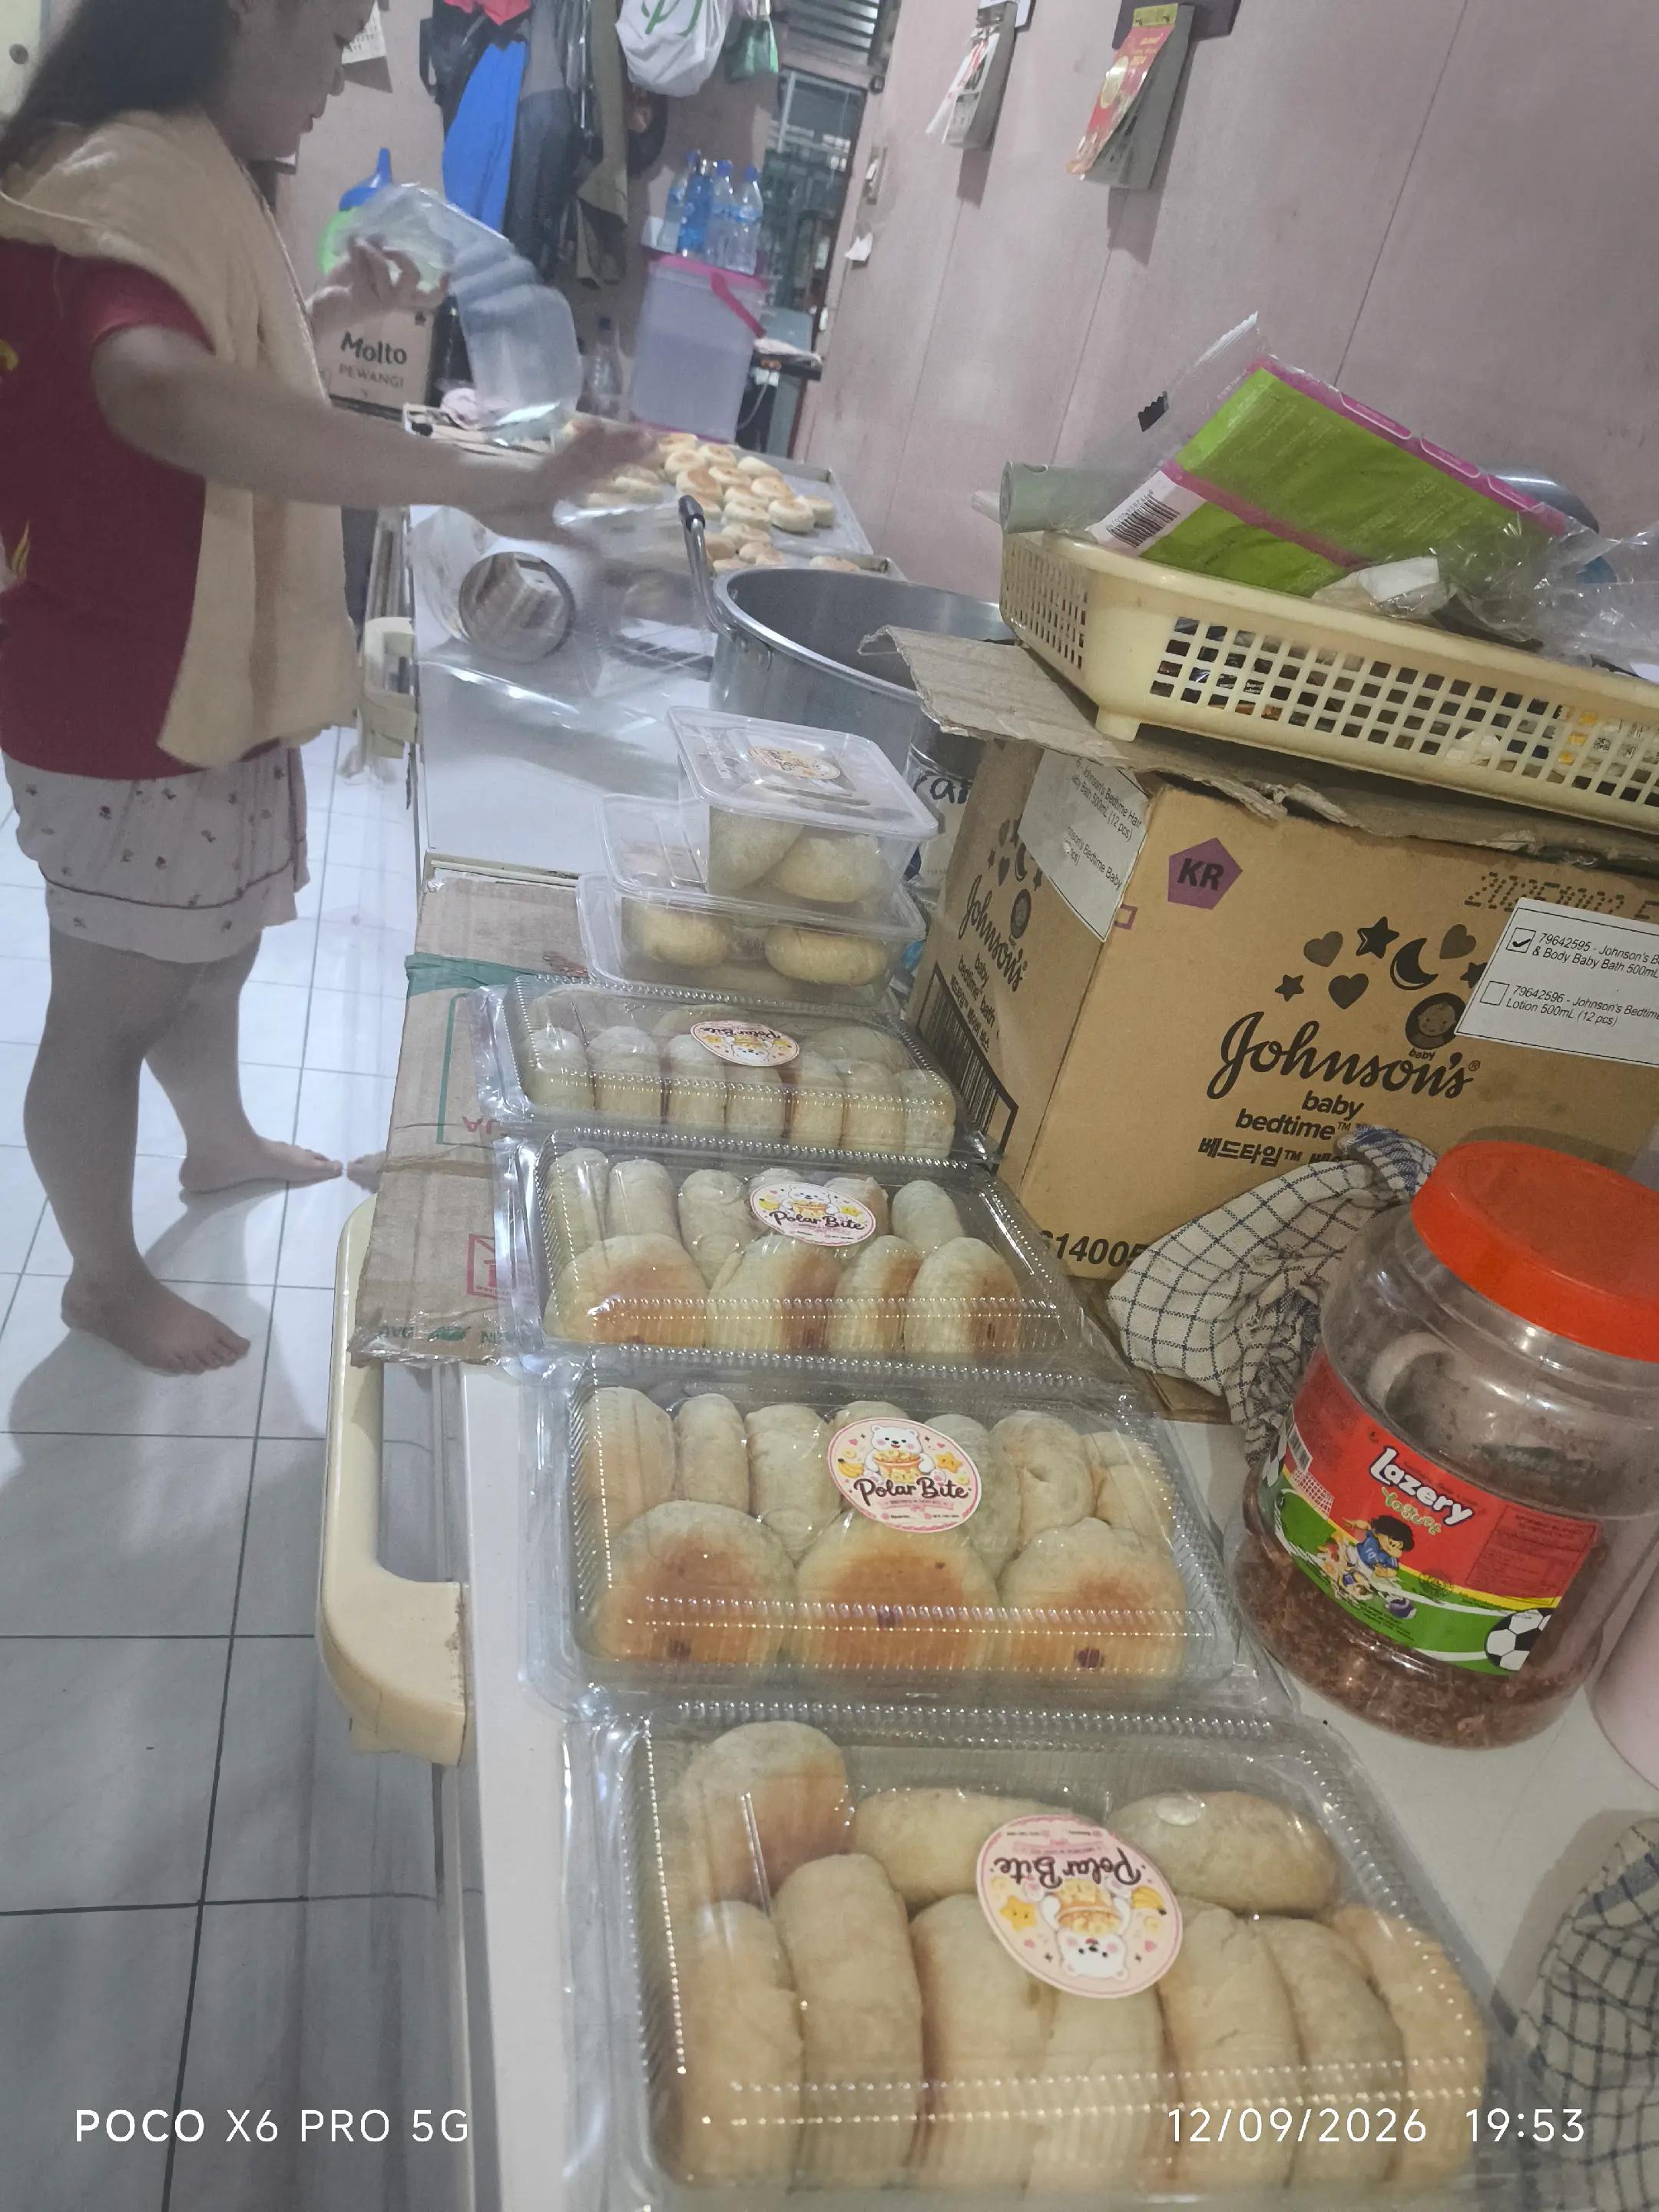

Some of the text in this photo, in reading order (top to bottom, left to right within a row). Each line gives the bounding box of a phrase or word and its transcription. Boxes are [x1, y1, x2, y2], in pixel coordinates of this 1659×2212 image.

[340, 332, 407, 365] Molto
[339, 363, 404, 388] PEWANGI
[1105, 866, 1123, 891] Baby
[1177, 857, 1225, 892] KR
[1532, 945, 1659, 979] & Body Baby Bath 500mL
[1538, 932, 1592, 952] 79642595
[1598, 945, 1651, 963] Johnson's
[1505, 998, 1619, 1028] Lotion 500mL (12 pcs)
[1512, 985, 1565, 1003] 79642596
[1572, 997, 1623, 1014] Johnson's
[1408, 1047, 1435, 1061] baby
[1301, 1090, 1364, 1121] baby
[769, 1210, 865, 1230] Polar Bite
[853, 1476, 969, 1507] Polar Bite
[1370, 1445, 1474, 1527] Lazery
[993, 1847, 1141, 1889] Polar Bite
